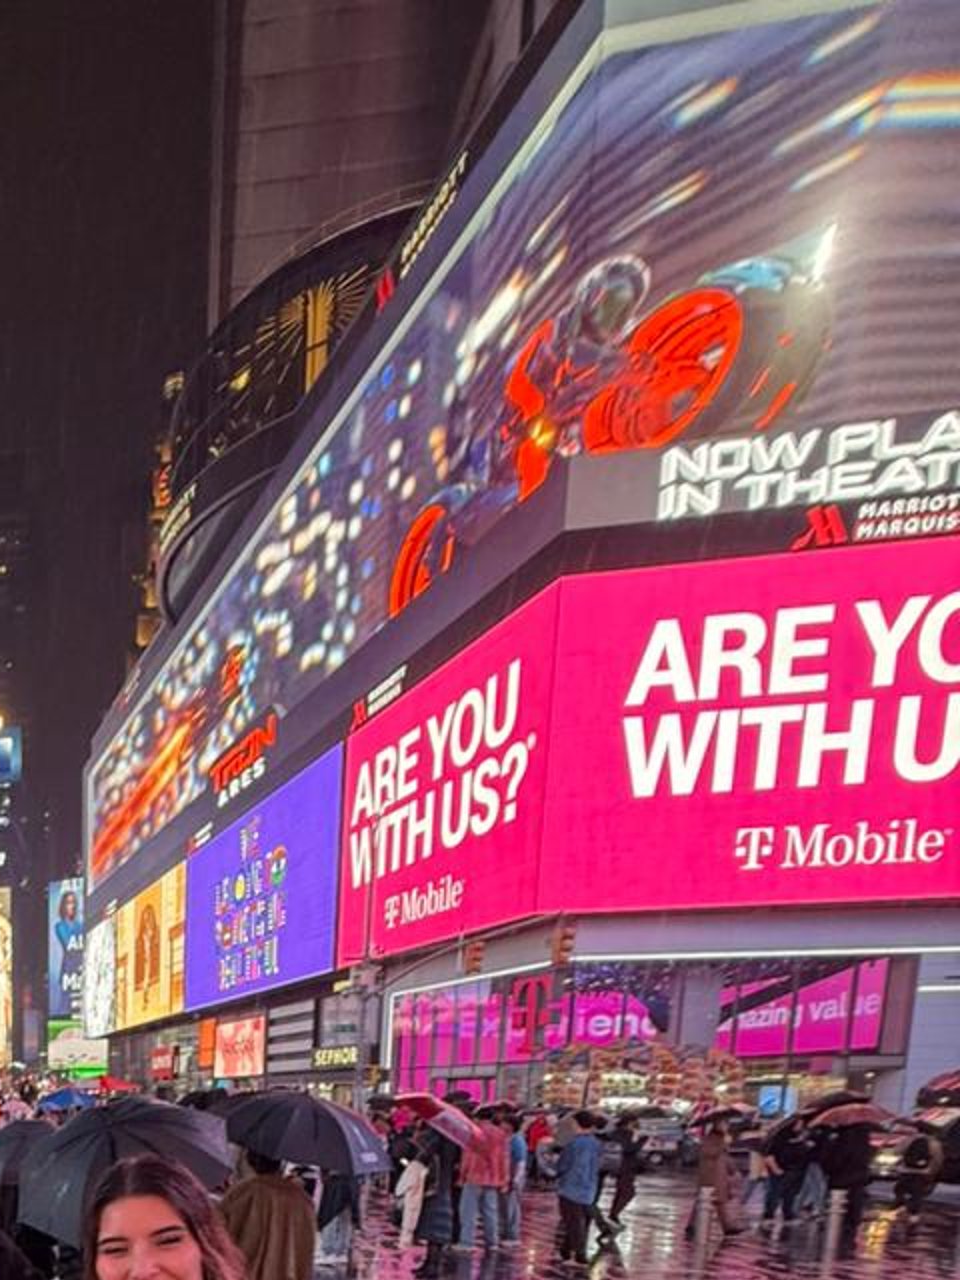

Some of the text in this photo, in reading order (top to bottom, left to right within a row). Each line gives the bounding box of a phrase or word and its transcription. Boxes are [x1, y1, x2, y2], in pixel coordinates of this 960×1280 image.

[660, 408, 960, 487] NOW PLA
[657, 479, 723, 520] IN
[855, 511, 960, 540] MARQUIS
[624, 604, 837, 707] ARE
[217, 756, 266, 808] ARES
[351, 726, 421, 828] ARE
[427, 657, 522, 782] YOU
[623, 698, 875, 798] WITH
[350, 738, 529, 890] WITH US?
[781, 818, 945, 869] Mobile
